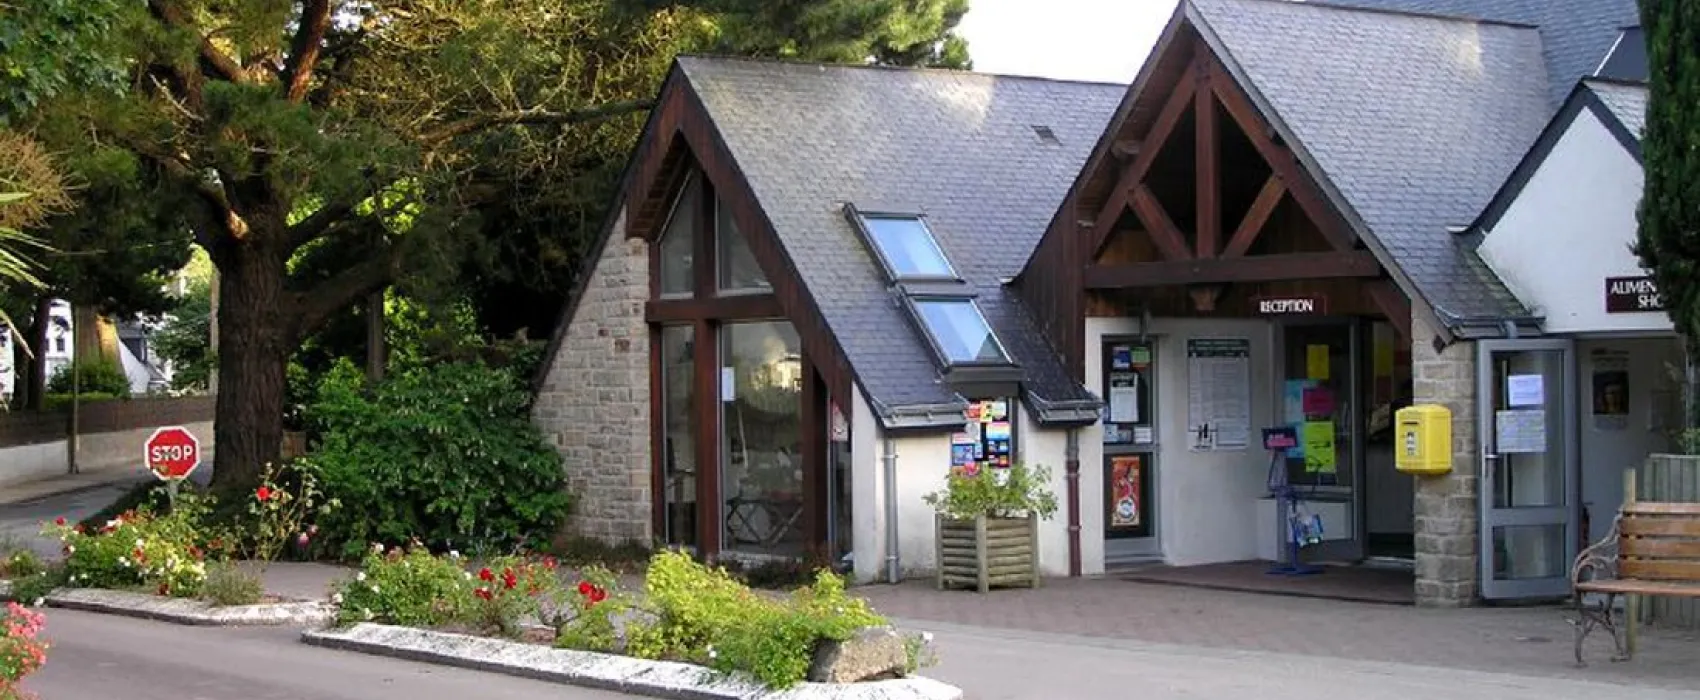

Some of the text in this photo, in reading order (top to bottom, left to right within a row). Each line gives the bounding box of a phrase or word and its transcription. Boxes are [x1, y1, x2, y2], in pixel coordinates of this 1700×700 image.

[1611, 280, 1657, 294] ALIMEN
[1260, 299, 1313, 313] RECEPTION
[1637, 293, 1664, 308] SHO
[152, 444, 193, 462] STOP
